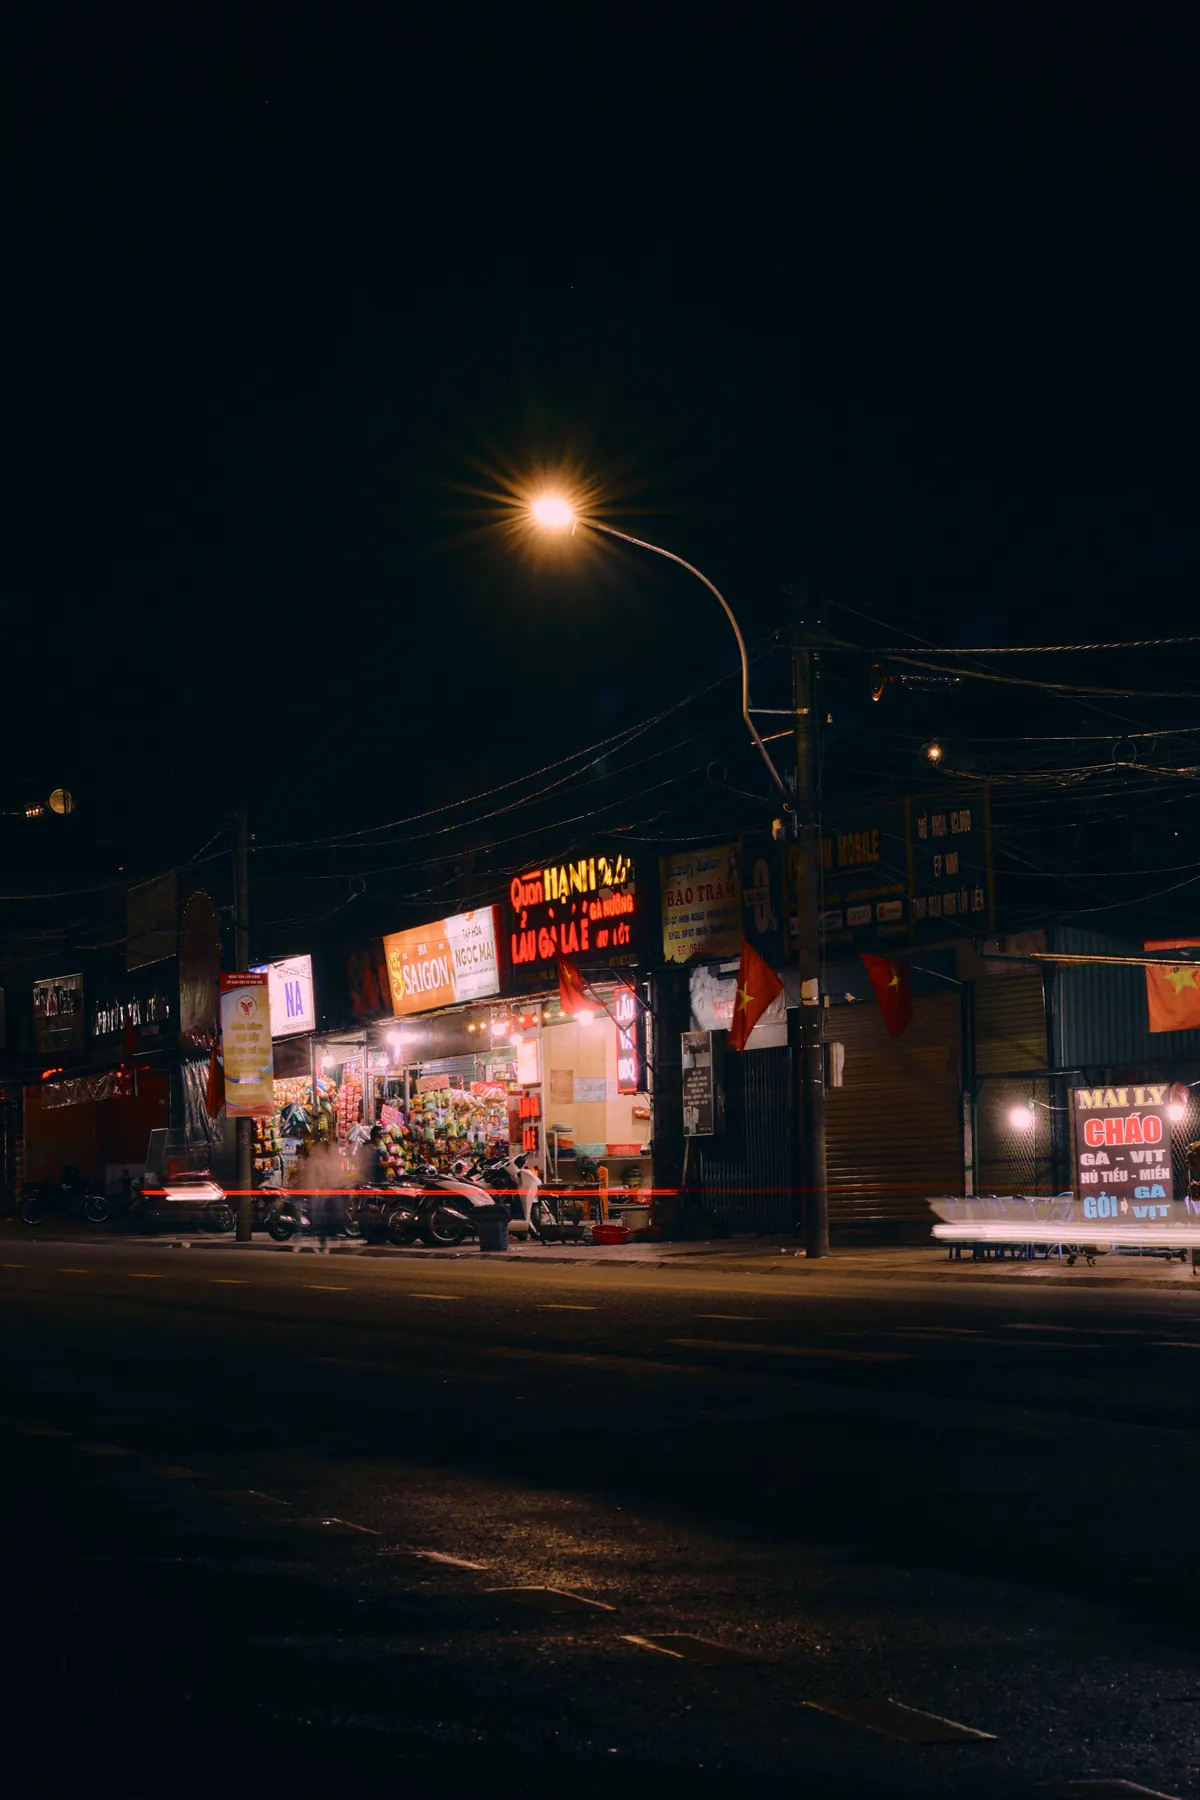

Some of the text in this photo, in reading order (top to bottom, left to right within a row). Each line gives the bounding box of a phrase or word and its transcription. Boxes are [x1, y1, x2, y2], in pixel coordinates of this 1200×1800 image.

[455, 940, 496, 970] NGỌC MAI
[402, 955, 450, 996] SAIGON
[284, 981, 305, 1018] NA
[1078, 1085, 1167, 1110] MAI LY
[1084, 1112, 1163, 1147] CHÁO
[1080, 1150, 1111, 1166] GÀ
[1129, 1149, 1167, 1165] VỊT
[1081, 1168, 1099, 1184] HỦ
[1134, 1183, 1167, 1199] GÀ
[1083, 1191, 1119, 1219] GỎI
[1131, 1204, 1171, 1220] VỊT
